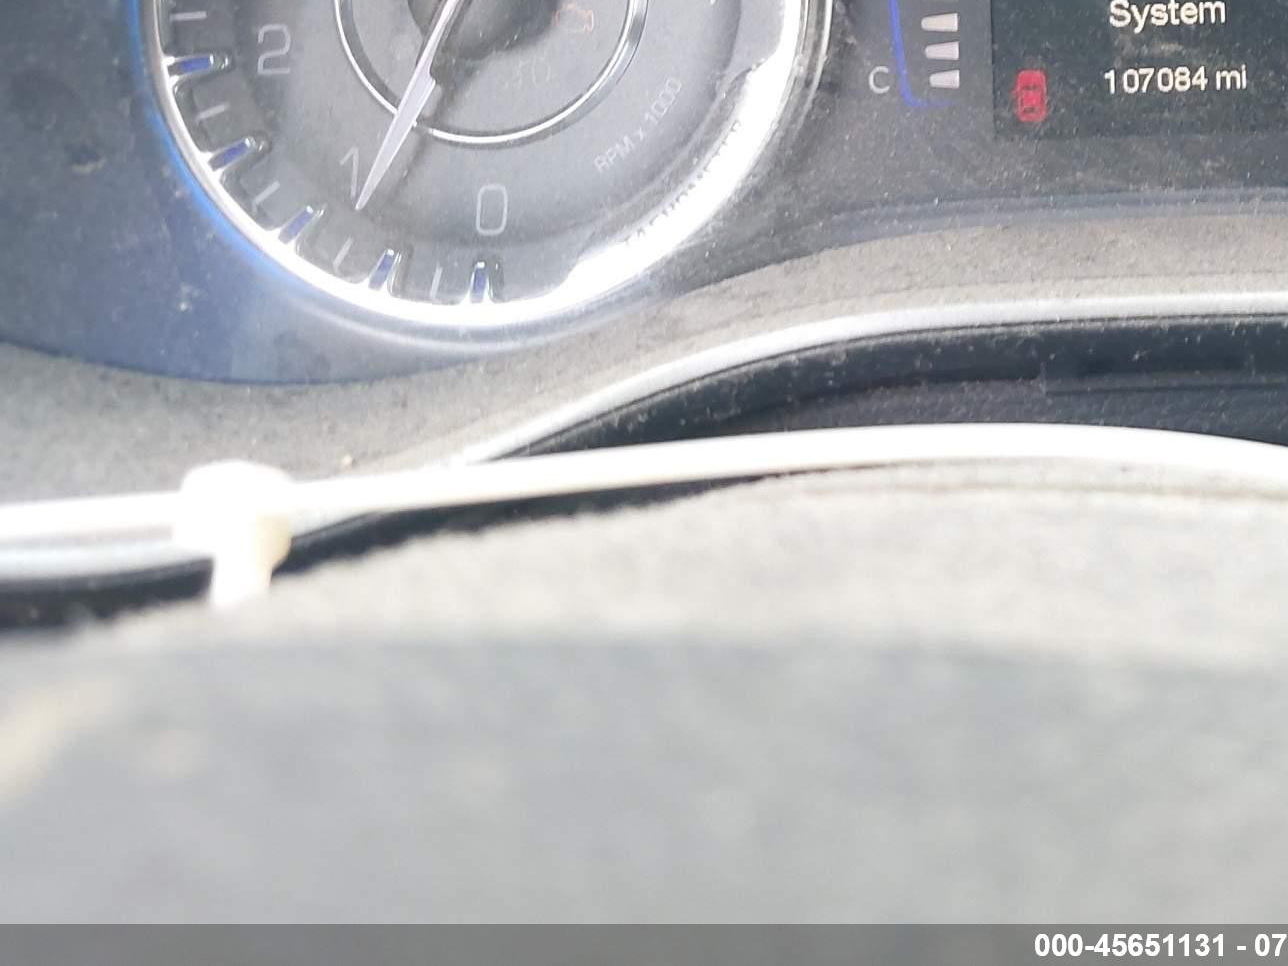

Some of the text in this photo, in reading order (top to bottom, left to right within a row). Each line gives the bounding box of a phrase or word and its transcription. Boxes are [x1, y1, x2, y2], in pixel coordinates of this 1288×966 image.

[258, 24, 291, 74] 2
[869, 67, 890, 92] C
[1104, 65, 1248, 94] 107084 mi
[594, 135, 636, 171] RPM
[644, 77, 682, 125] 1000
[340, 147, 359, 203] 1
[476, 185, 508, 235] 0
